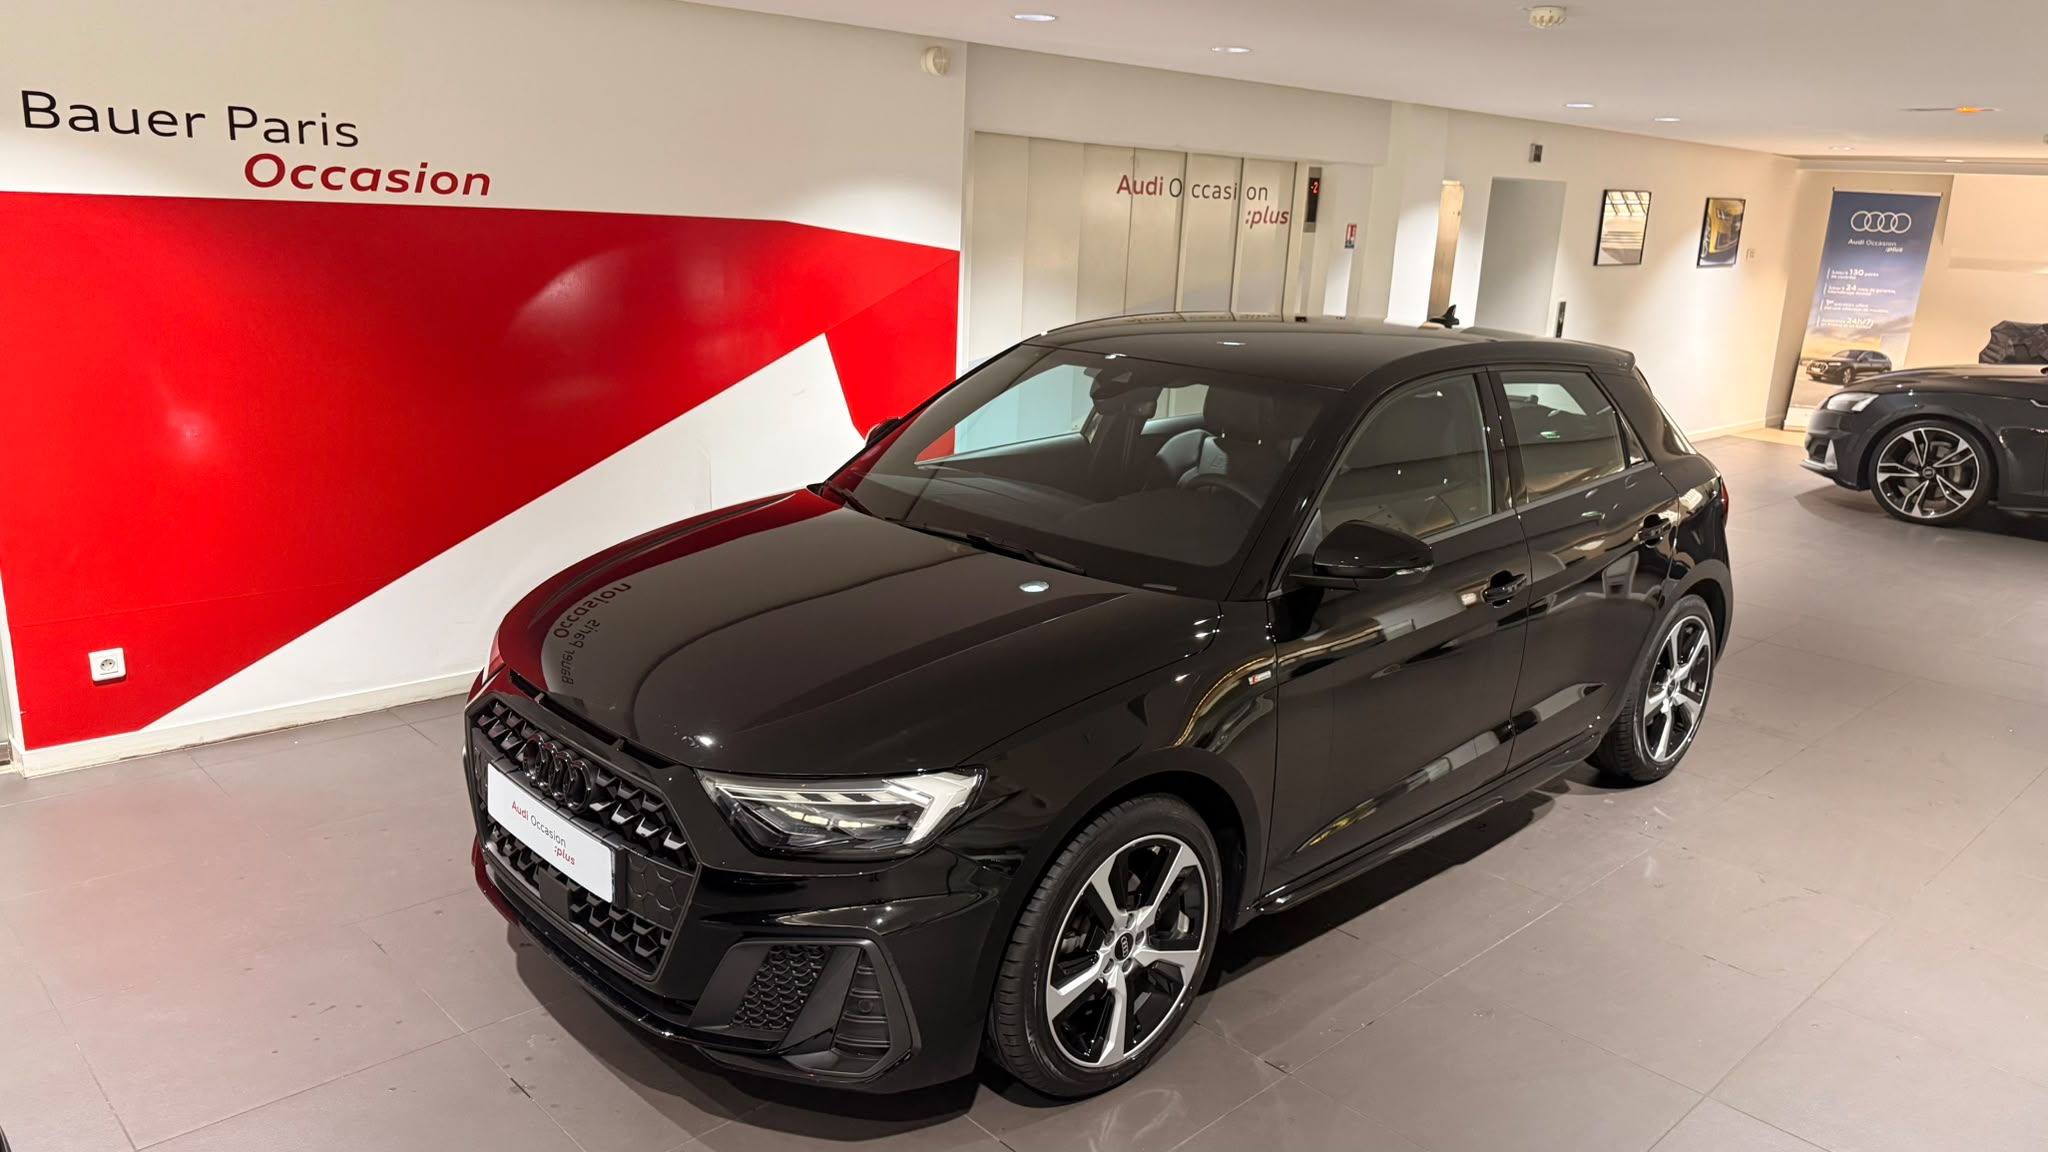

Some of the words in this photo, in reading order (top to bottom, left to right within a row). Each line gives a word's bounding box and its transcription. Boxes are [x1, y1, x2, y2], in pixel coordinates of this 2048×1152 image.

[20, 90, 206, 138] Bauer
[227, 105, 360, 147] Paris
[244, 153, 492, 196] Occasion
[1116, 174, 1164, 196] Audi
[1245, 206, 1290, 229] :plus
[1848, 238, 1865, 246] Audi
[1865, 239, 1897, 247] Occasion
[1849, 268, 1864, 277] 130
[511, 800, 529, 821] Audi
[530, 814, 567, 849] Occasion
[554, 845, 576, 866] :plus
